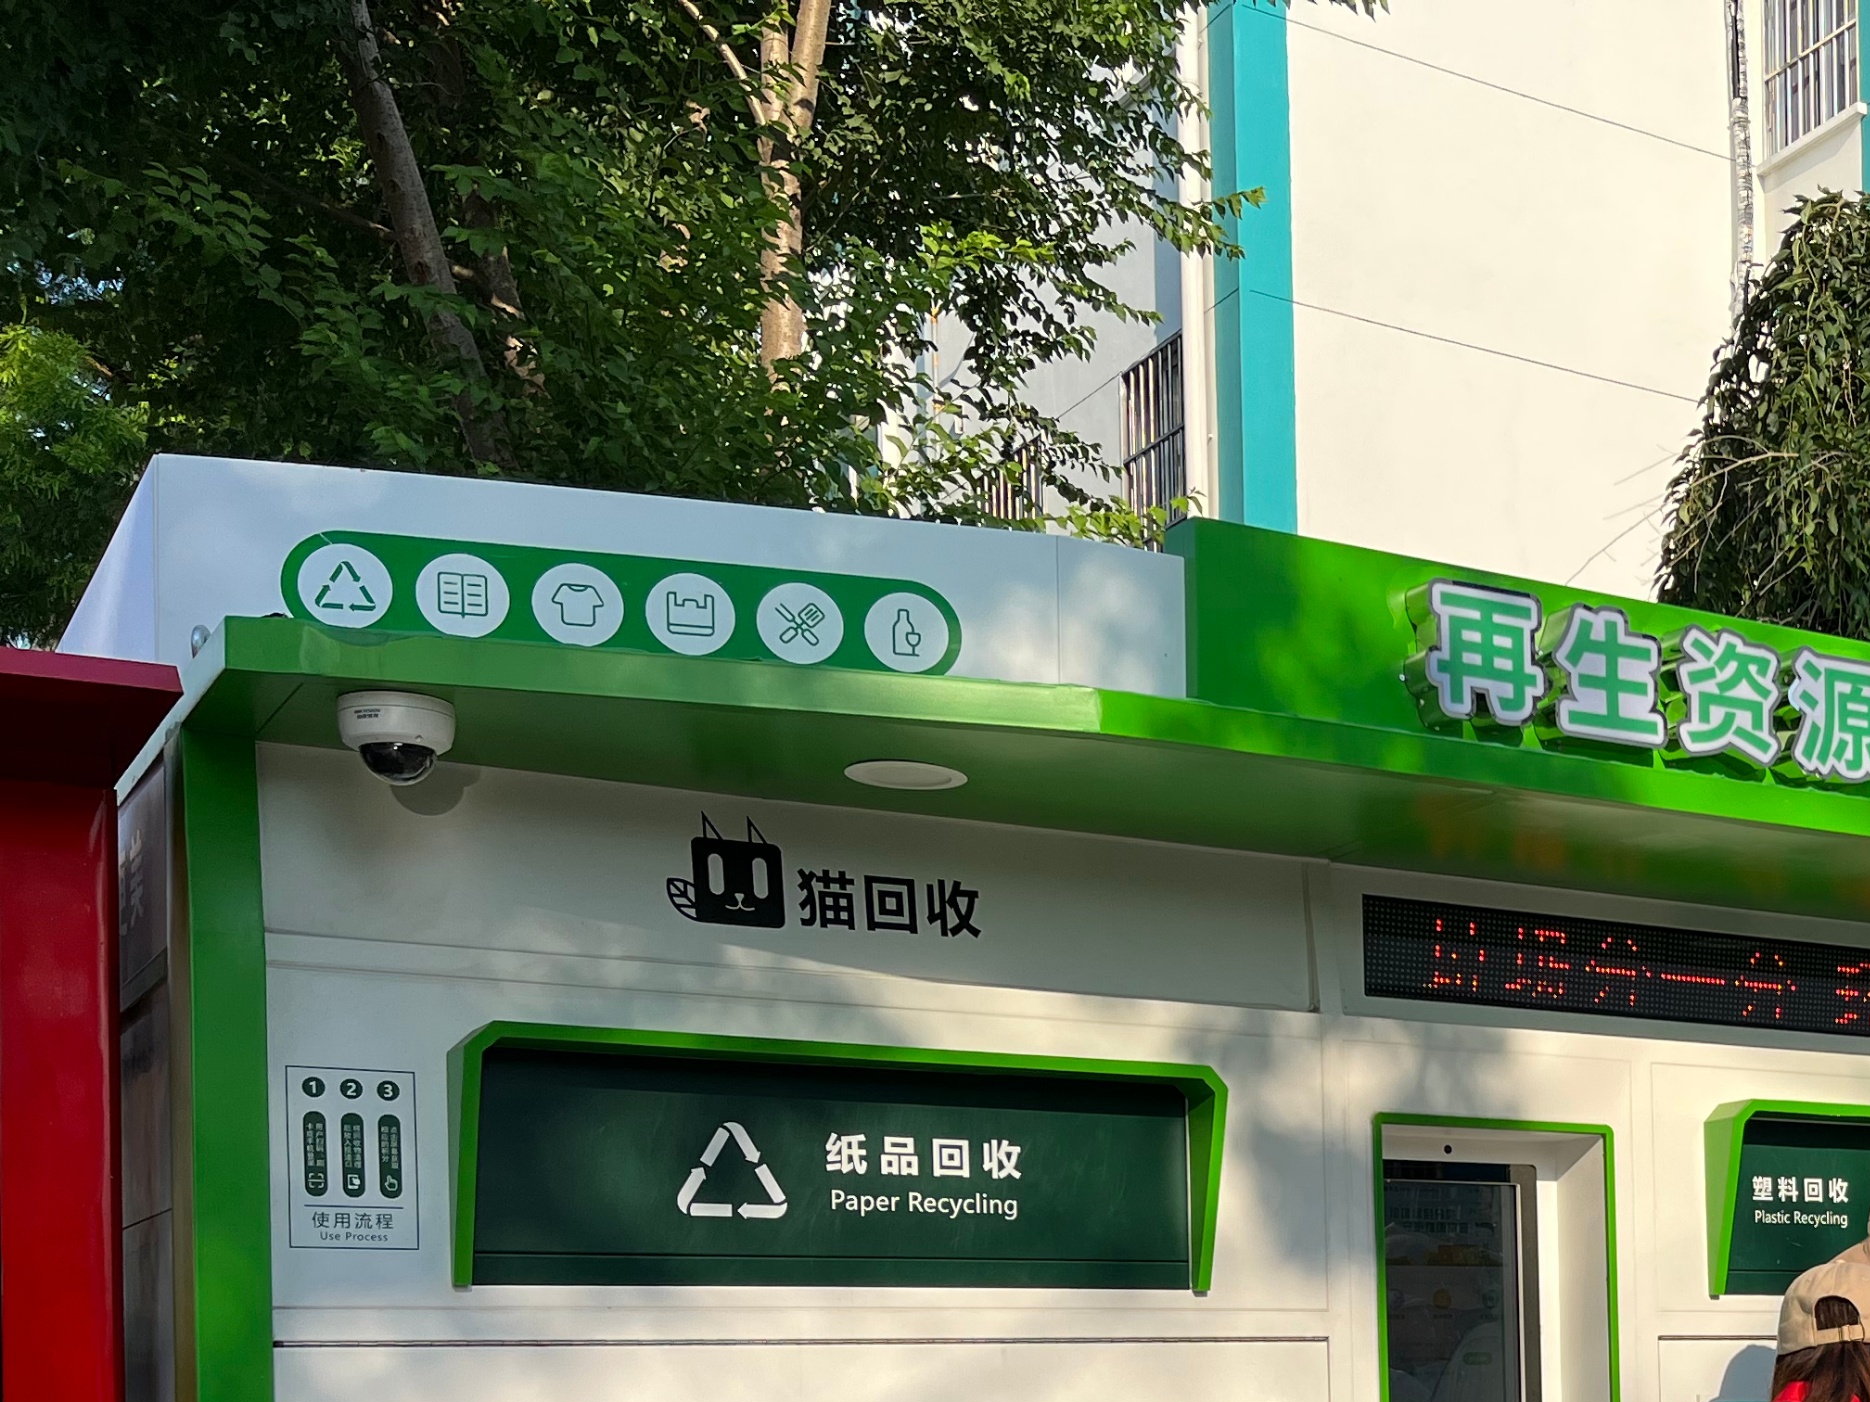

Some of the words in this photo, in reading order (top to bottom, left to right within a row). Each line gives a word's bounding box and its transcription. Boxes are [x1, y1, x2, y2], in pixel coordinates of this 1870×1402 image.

[796, 867, 982, 939] 猫回收
[824, 1132, 1023, 1180] 纸品回收
[1751, 1175, 1850, 1204] 塑料回收
[830, 1189, 900, 1214] Paper
[908, 1192, 1018, 1221] Recycling
[1754, 1210, 1790, 1226] Plastic
[1793, 1210, 1849, 1229] Recycling
[311, 1210, 394, 1230] 使用流程
[319, 1231, 343, 1241] Use
[345, 1232, 388, 1242] Process
